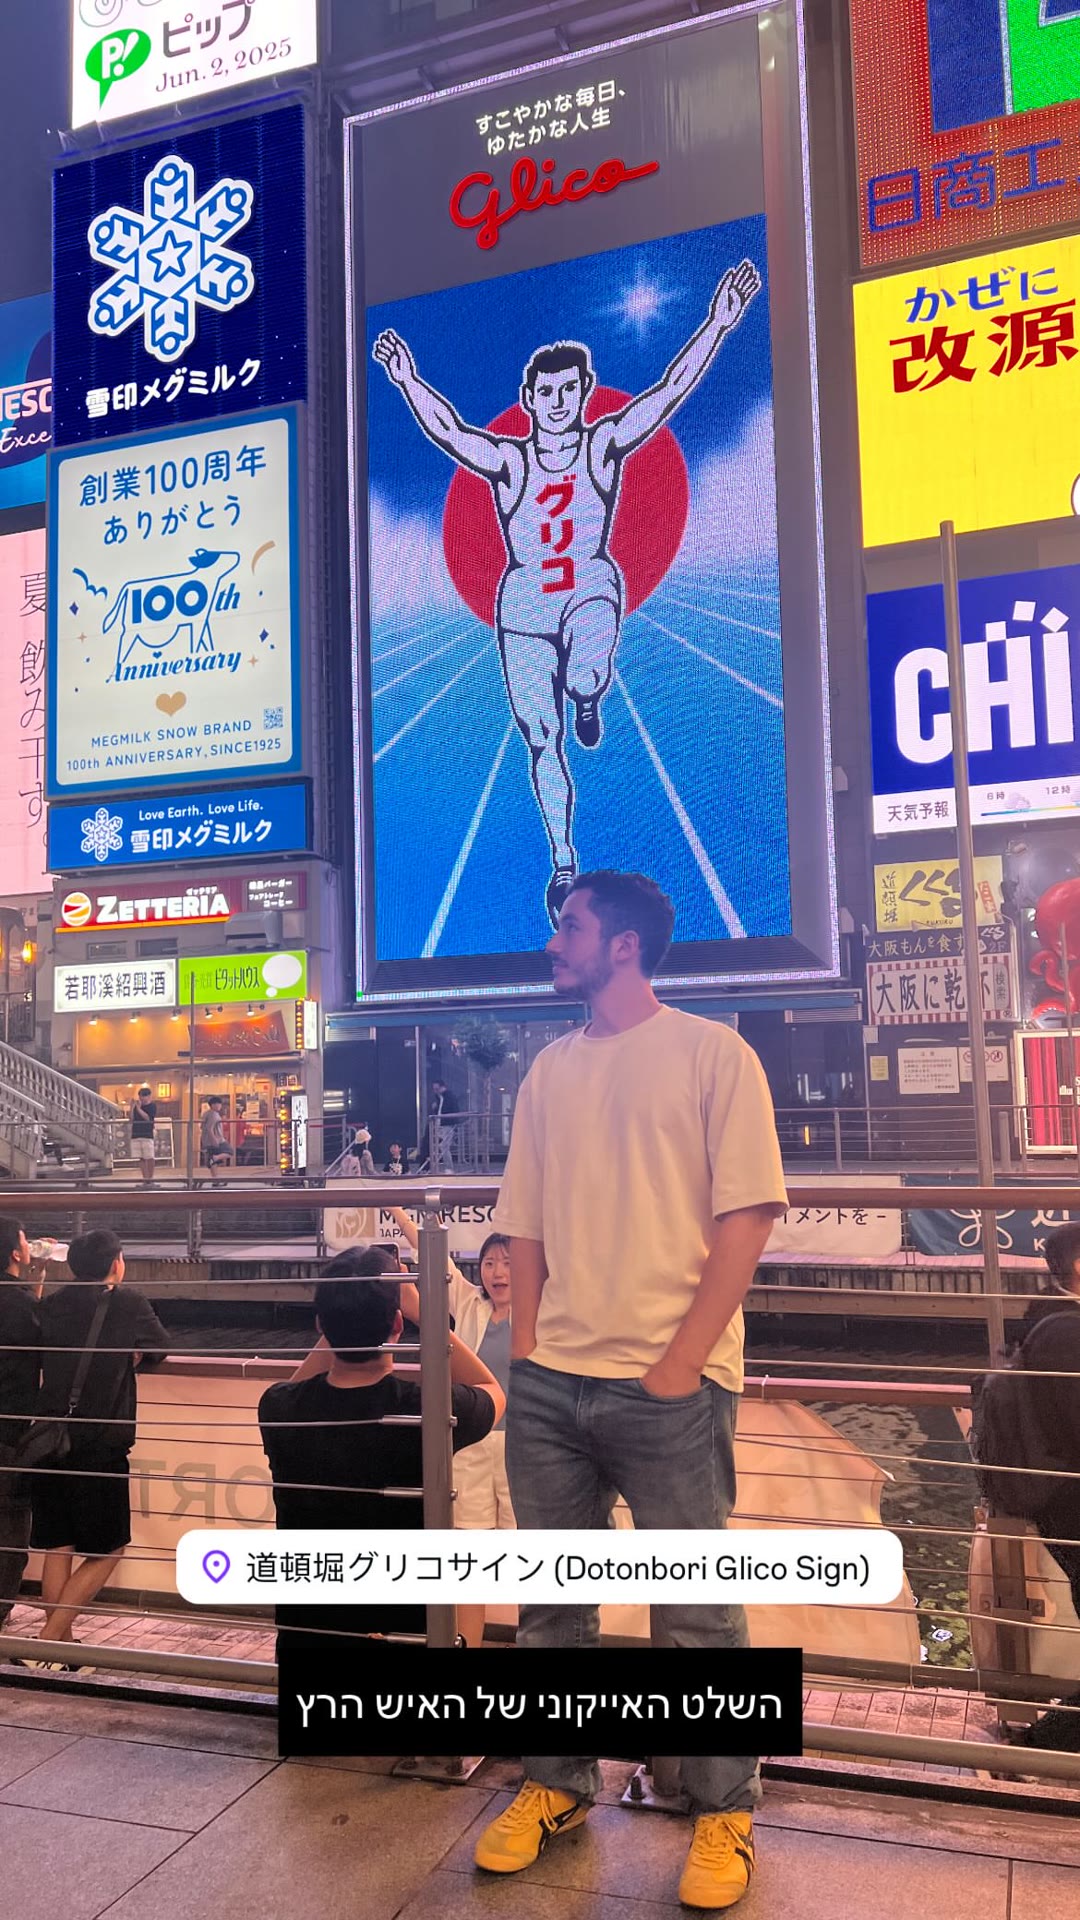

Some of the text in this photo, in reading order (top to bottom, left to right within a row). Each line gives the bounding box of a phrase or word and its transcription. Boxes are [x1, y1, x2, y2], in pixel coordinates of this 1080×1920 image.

[162, 0, 256, 58] ピップ
[156, 37, 292, 92] Jun. 2, 2025
[475, 80, 627, 135] すこやかな毎日、
[487, 107, 611, 156] ゆたかな人生
[448, 156, 660, 250] Glico
[905, 266, 1058, 323] かぜに
[889, 298, 1080, 393] 改源
[85, 358, 261, 419] 雪印メグミルク
[79, 445, 267, 507] 創業100周年
[103, 495, 241, 545] ありがとう
[535, 473, 576, 594] グリコ
[131, 580, 241, 624] 100th
[105, 651, 242, 684] Anniversary
[91, 719, 252, 748] MEGMILK SNOW BRAND
[66, 758, 100, 771] 100th
[139, 798, 264, 822] Love Earth. Love Life.
[888, 801, 950, 823] 天気予報
[130, 818, 273, 854] 雪印メグミルク
[96, 894, 230, 923] ZETTERIA
